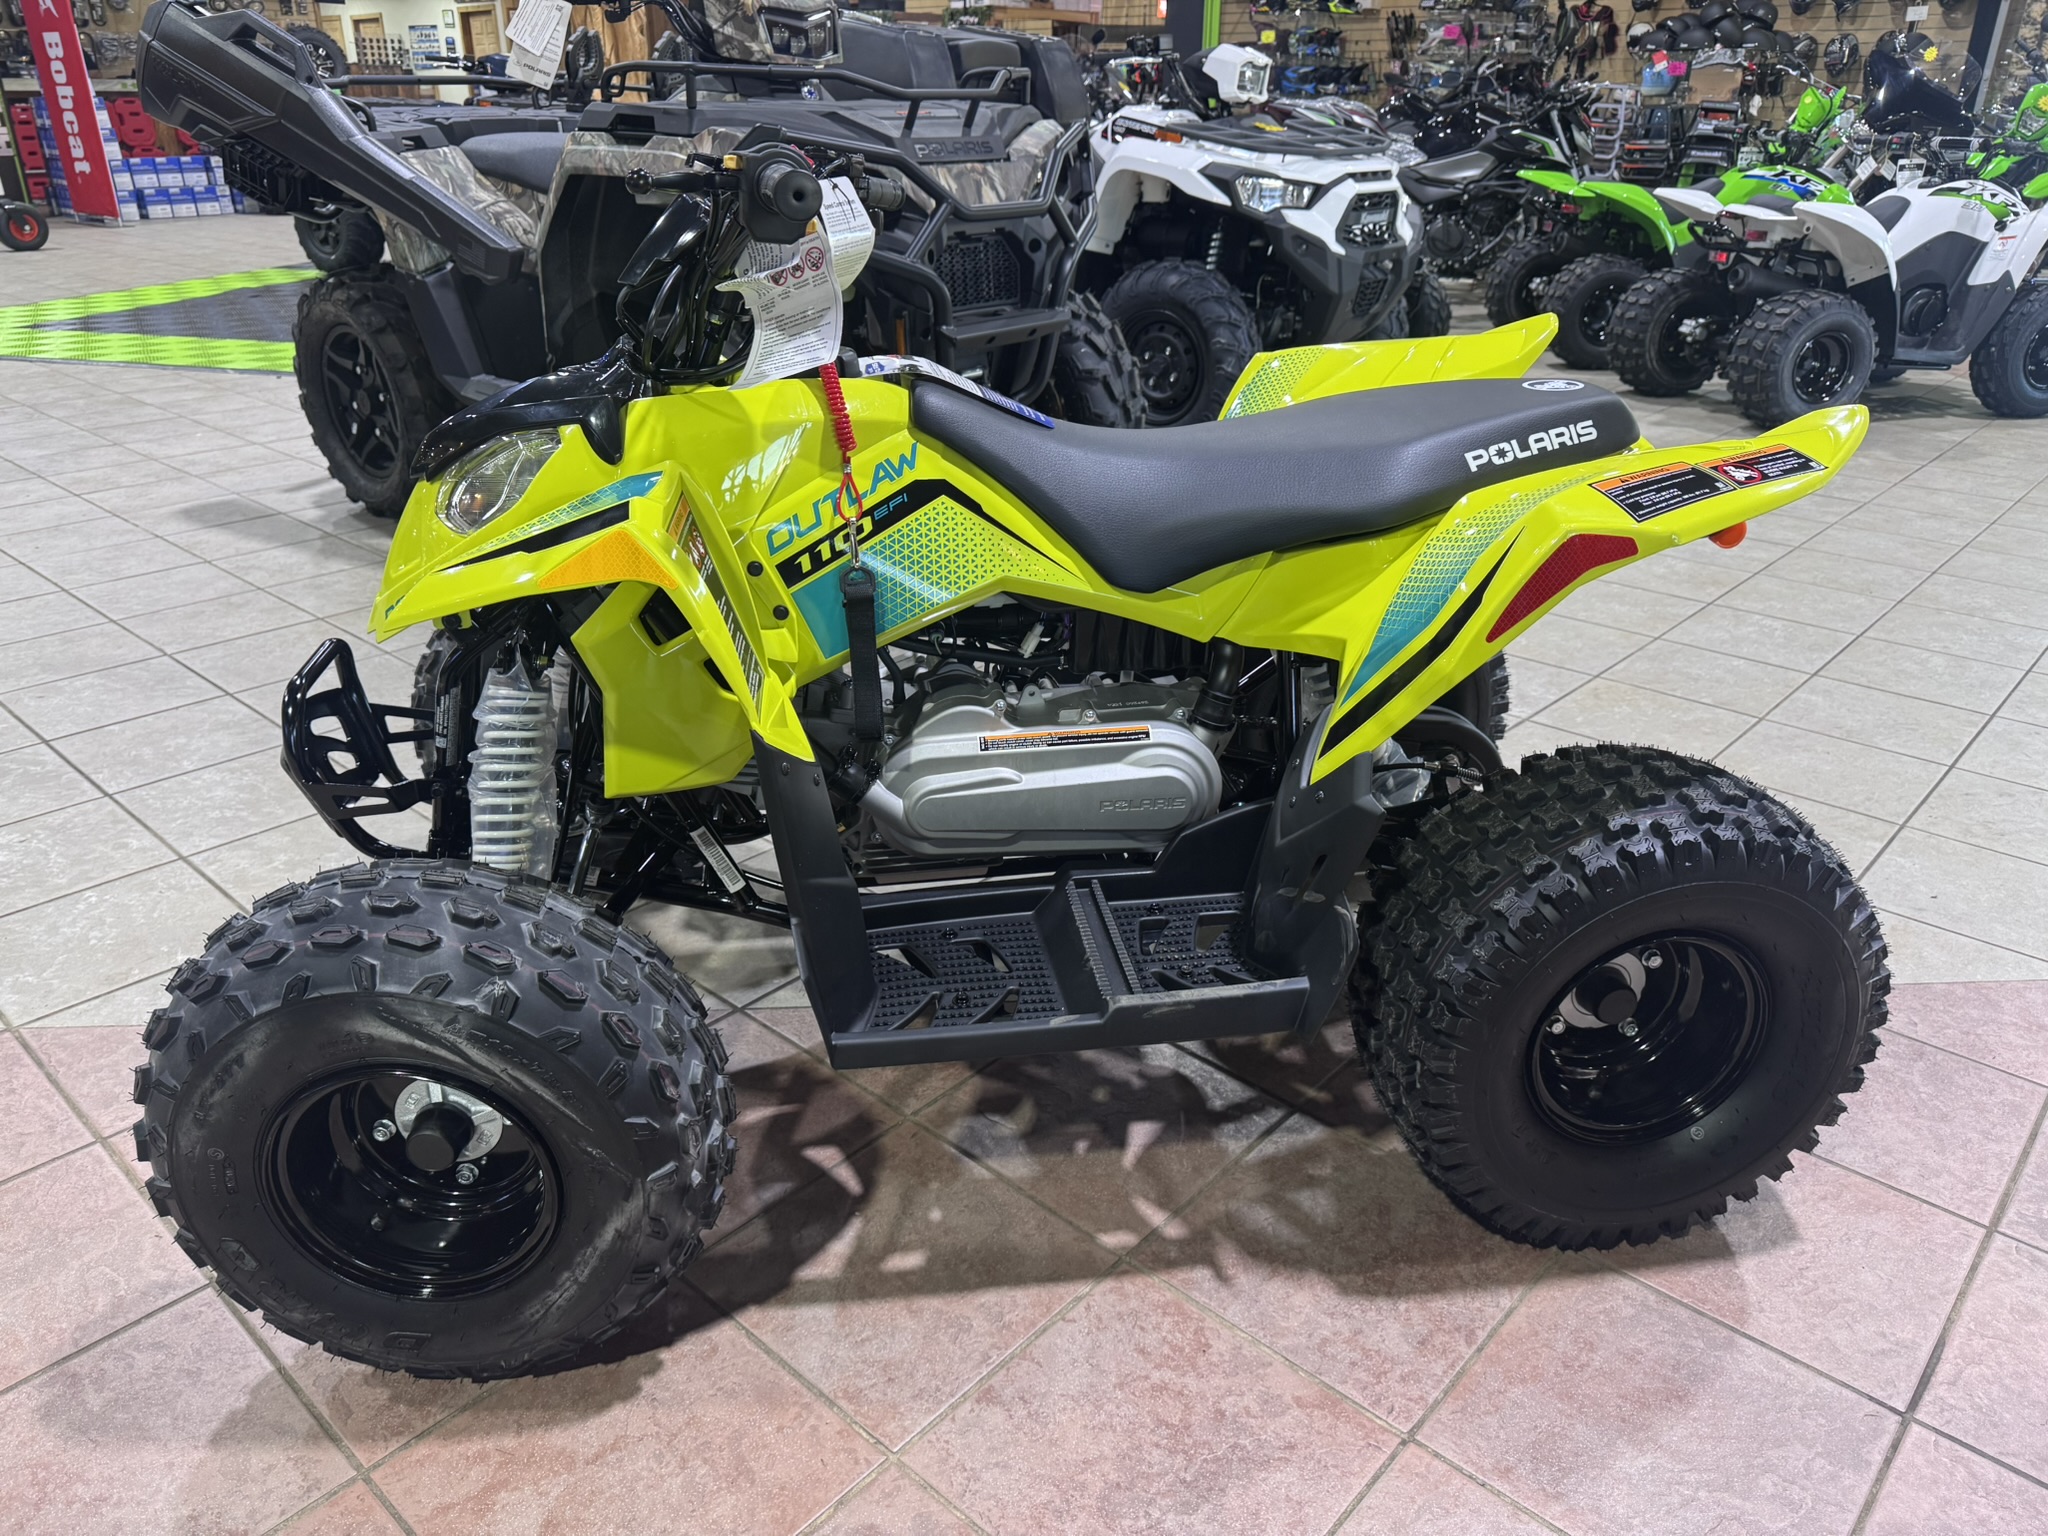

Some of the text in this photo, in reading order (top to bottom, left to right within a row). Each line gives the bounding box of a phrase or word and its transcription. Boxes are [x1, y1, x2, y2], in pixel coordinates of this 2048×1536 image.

[42, 31, 91, 175] Bobcat
[913, 140, 994, 158] POLARIS
[1464, 419, 1598, 473] POLARIS
[766, 440, 919, 558] OUTLAW
[794, 492, 908, 574] 110 EFI
[1100, 798, 1186, 813] POLARIS
